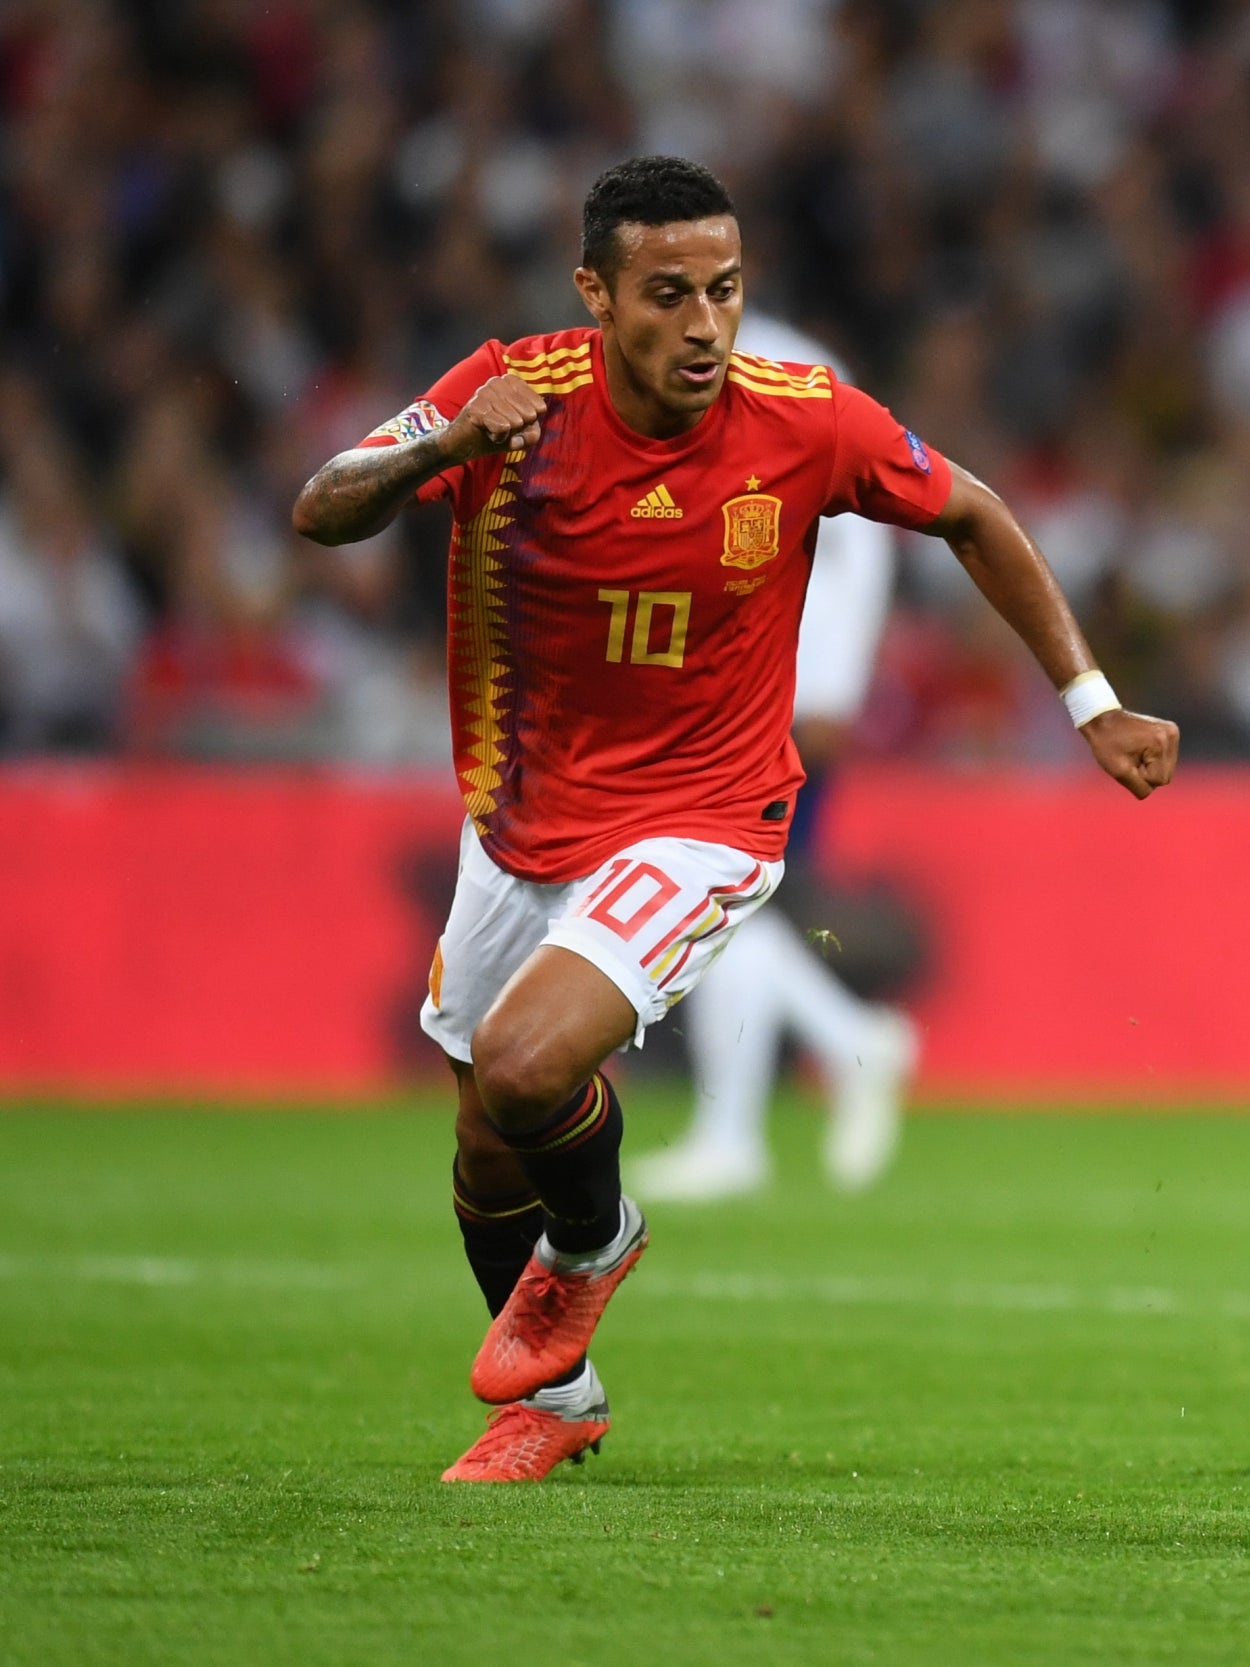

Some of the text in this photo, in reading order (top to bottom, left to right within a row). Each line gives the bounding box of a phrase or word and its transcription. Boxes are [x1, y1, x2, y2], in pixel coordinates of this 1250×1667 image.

[630, 505, 684, 519] adidas
[598, 588, 692, 669] 10
[573, 858, 682, 943] 10
